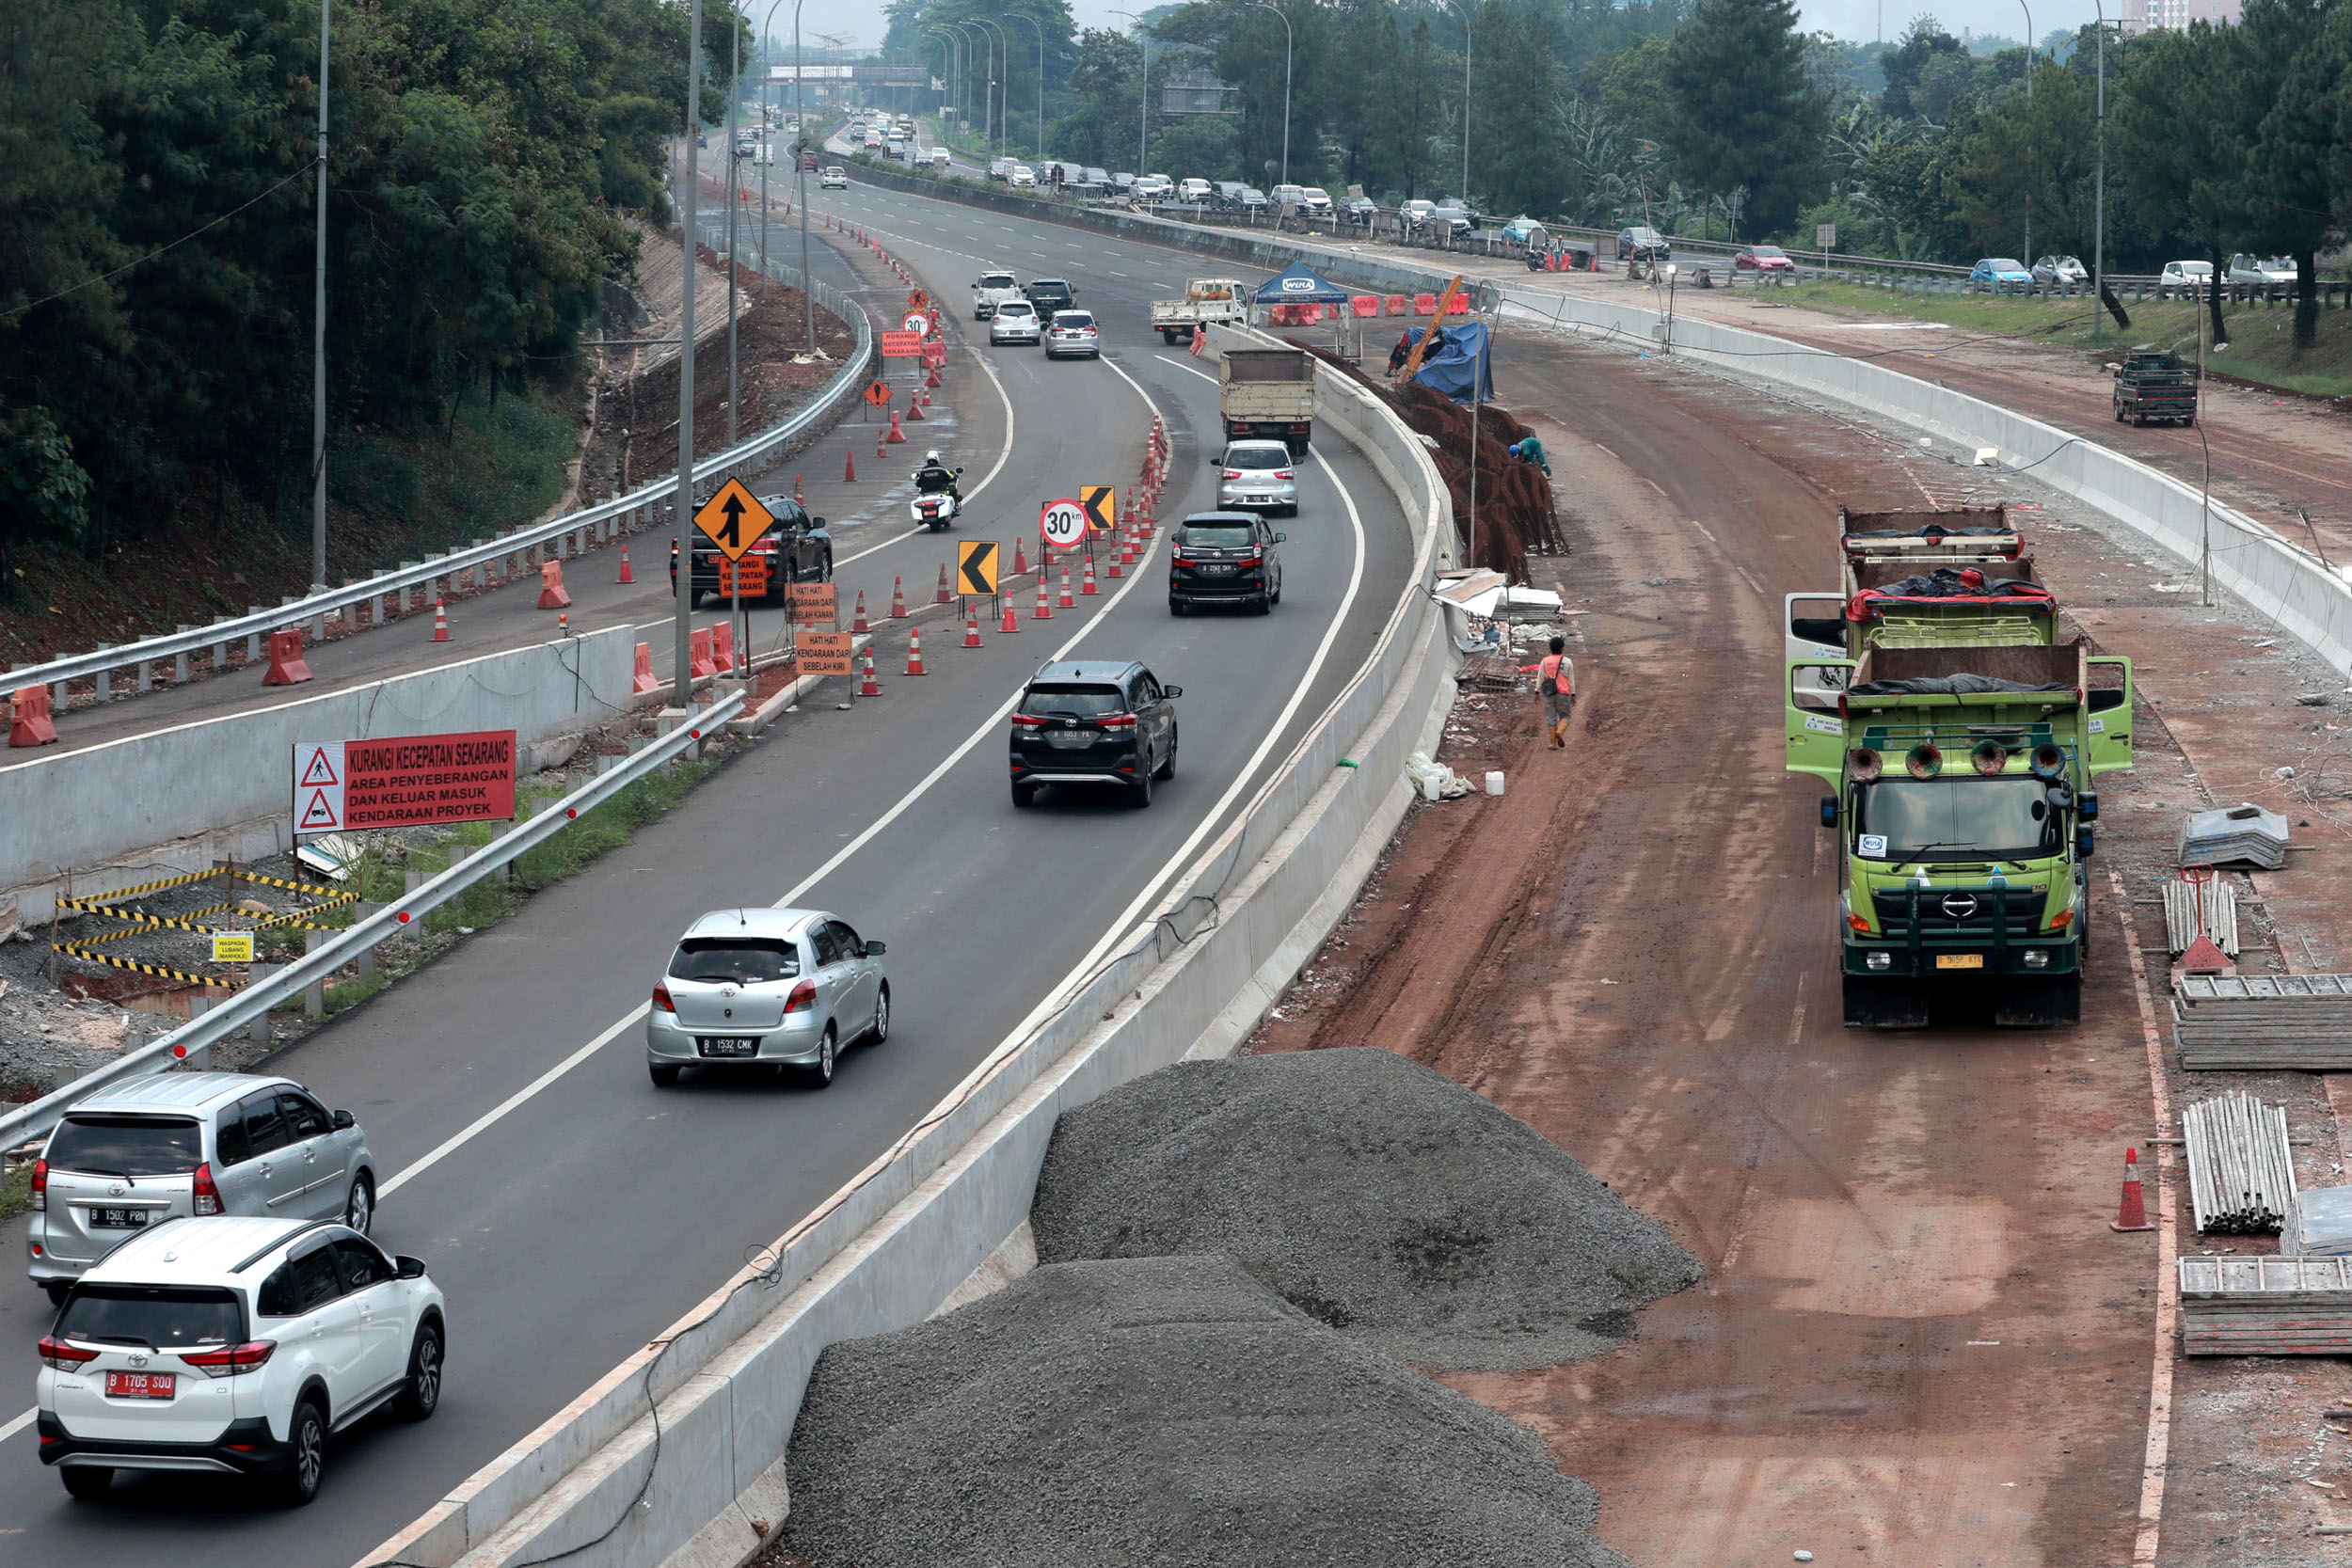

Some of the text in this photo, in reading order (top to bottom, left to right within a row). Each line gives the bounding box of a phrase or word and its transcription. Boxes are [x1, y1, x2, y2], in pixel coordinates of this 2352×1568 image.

[907, 320, 921, 332] 30
[1047, 512, 1083, 534] 30 km
[725, 561, 759, 570] KRANGI
[722, 572, 764, 580] KEEPATAN
[723, 582, 763, 592] SEARANG
[814, 610, 834, 619] KANAN
[810, 636, 838, 645] HATI HATI
[798, 649, 850, 658] KENDARAAN DARI
[803, 661, 845, 671] SEBELAH KIRI
[350, 739, 509, 772] KURANGI KECEPATAN SEKARANG
[349, 769, 508, 790] AREA PENYEBERANGAN
[349, 787, 487, 807] DAN KELUAR MASUK
[349, 802, 491, 823] KENDARAAN PROYEK
[704, 1039, 753, 1049] B 1532 CMK
[91, 1209, 98, 1220] B
[105, 1210, 125, 1221] 1502
[110, 1374, 118, 1386] B
[124, 1375, 149, 1388] 1705
